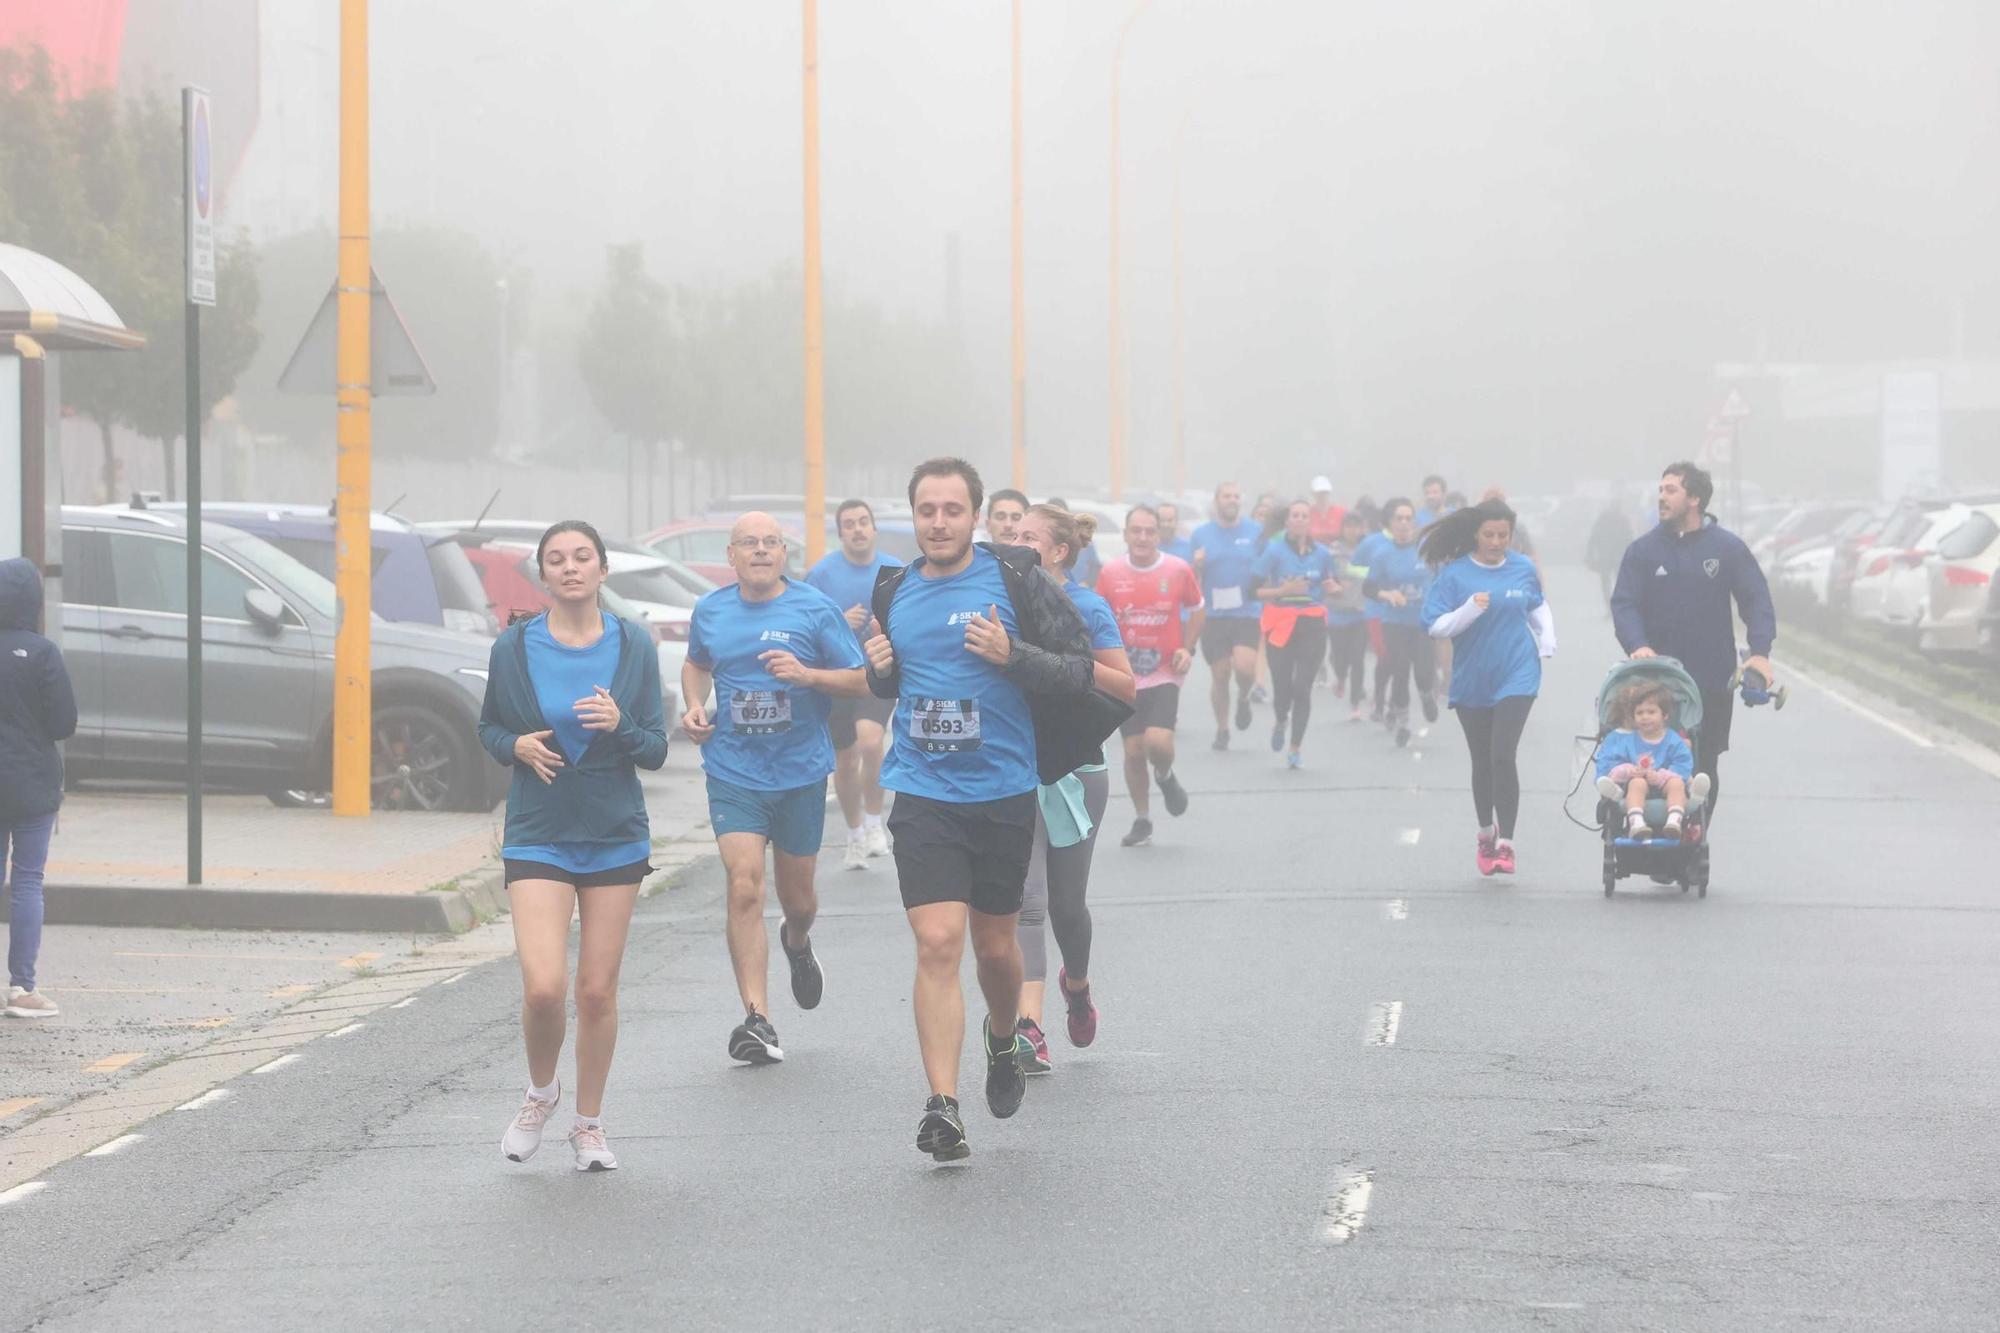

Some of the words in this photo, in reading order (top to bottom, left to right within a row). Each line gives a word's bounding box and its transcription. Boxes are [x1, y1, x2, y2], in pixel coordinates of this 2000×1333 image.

[936, 700, 957, 708] 5KM
[741, 706, 777, 720] 0973
[921, 718, 963, 735] 0593
